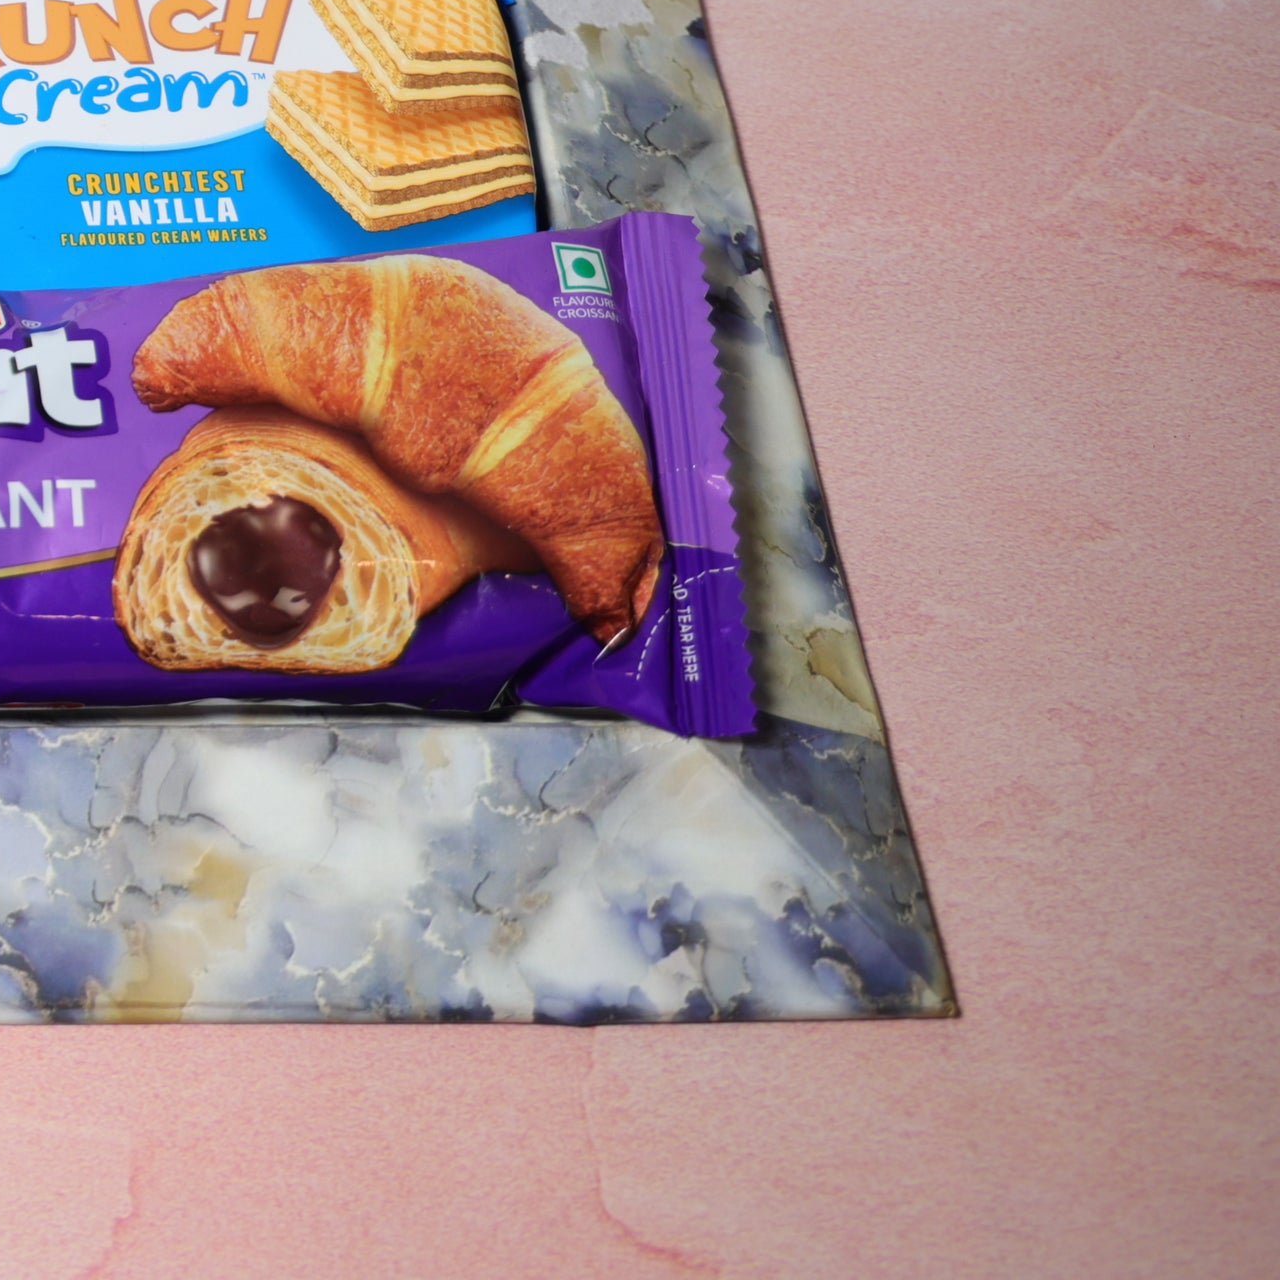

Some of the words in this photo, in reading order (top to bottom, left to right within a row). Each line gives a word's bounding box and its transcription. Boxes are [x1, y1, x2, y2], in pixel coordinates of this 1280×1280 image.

[66, 169, 246, 196] CRUNCHIEST
[80, 197, 240, 227] VANILLA
[60, 230, 146, 247] FLAVOURED
[151, 229, 202, 245] CREAM
[206, 228, 268, 243] WAFERS
[677, 606, 694, 642] TEAR
[681, 645, 699, 682] HERE
